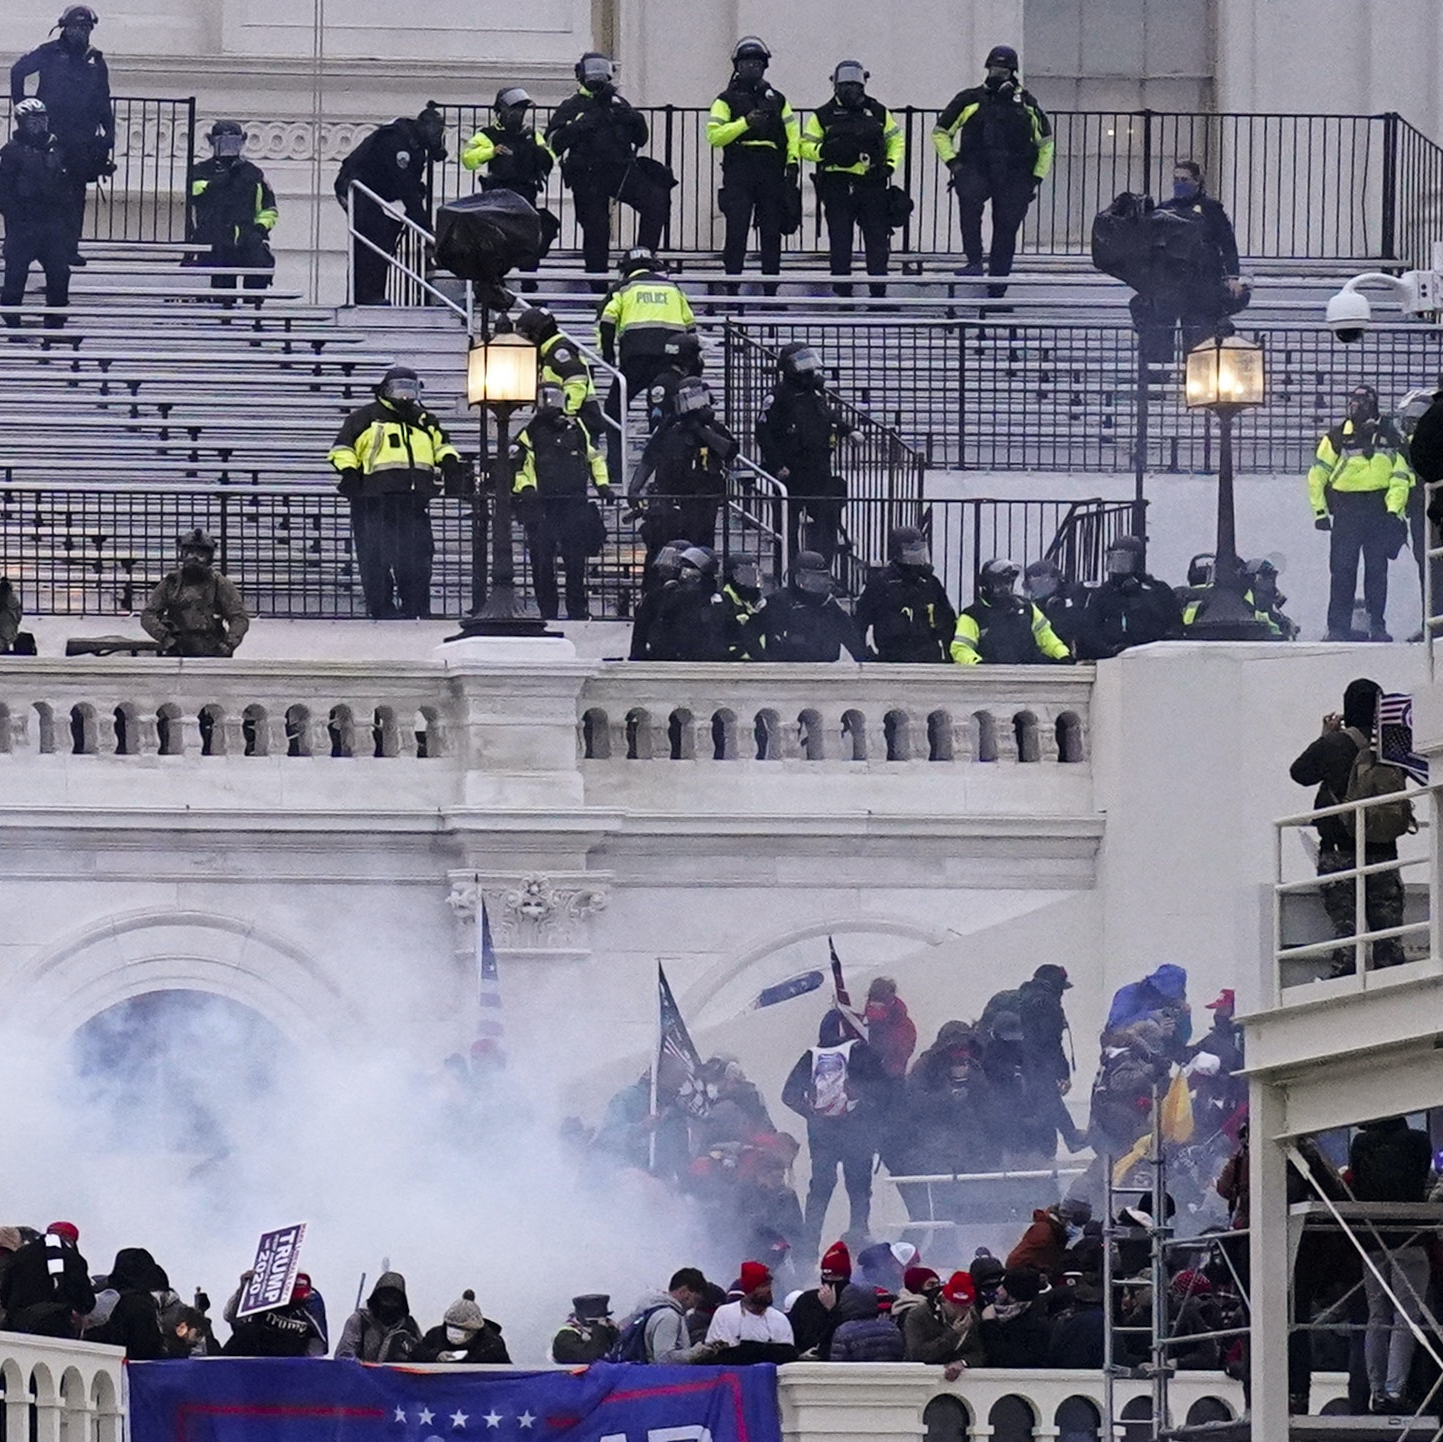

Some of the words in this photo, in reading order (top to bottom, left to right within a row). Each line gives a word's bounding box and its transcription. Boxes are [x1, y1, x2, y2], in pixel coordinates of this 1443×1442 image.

[636, 291, 669, 305] POLICE
[249, 1250, 271, 1296] 2020
[263, 1230, 297, 1303] TRUMP
